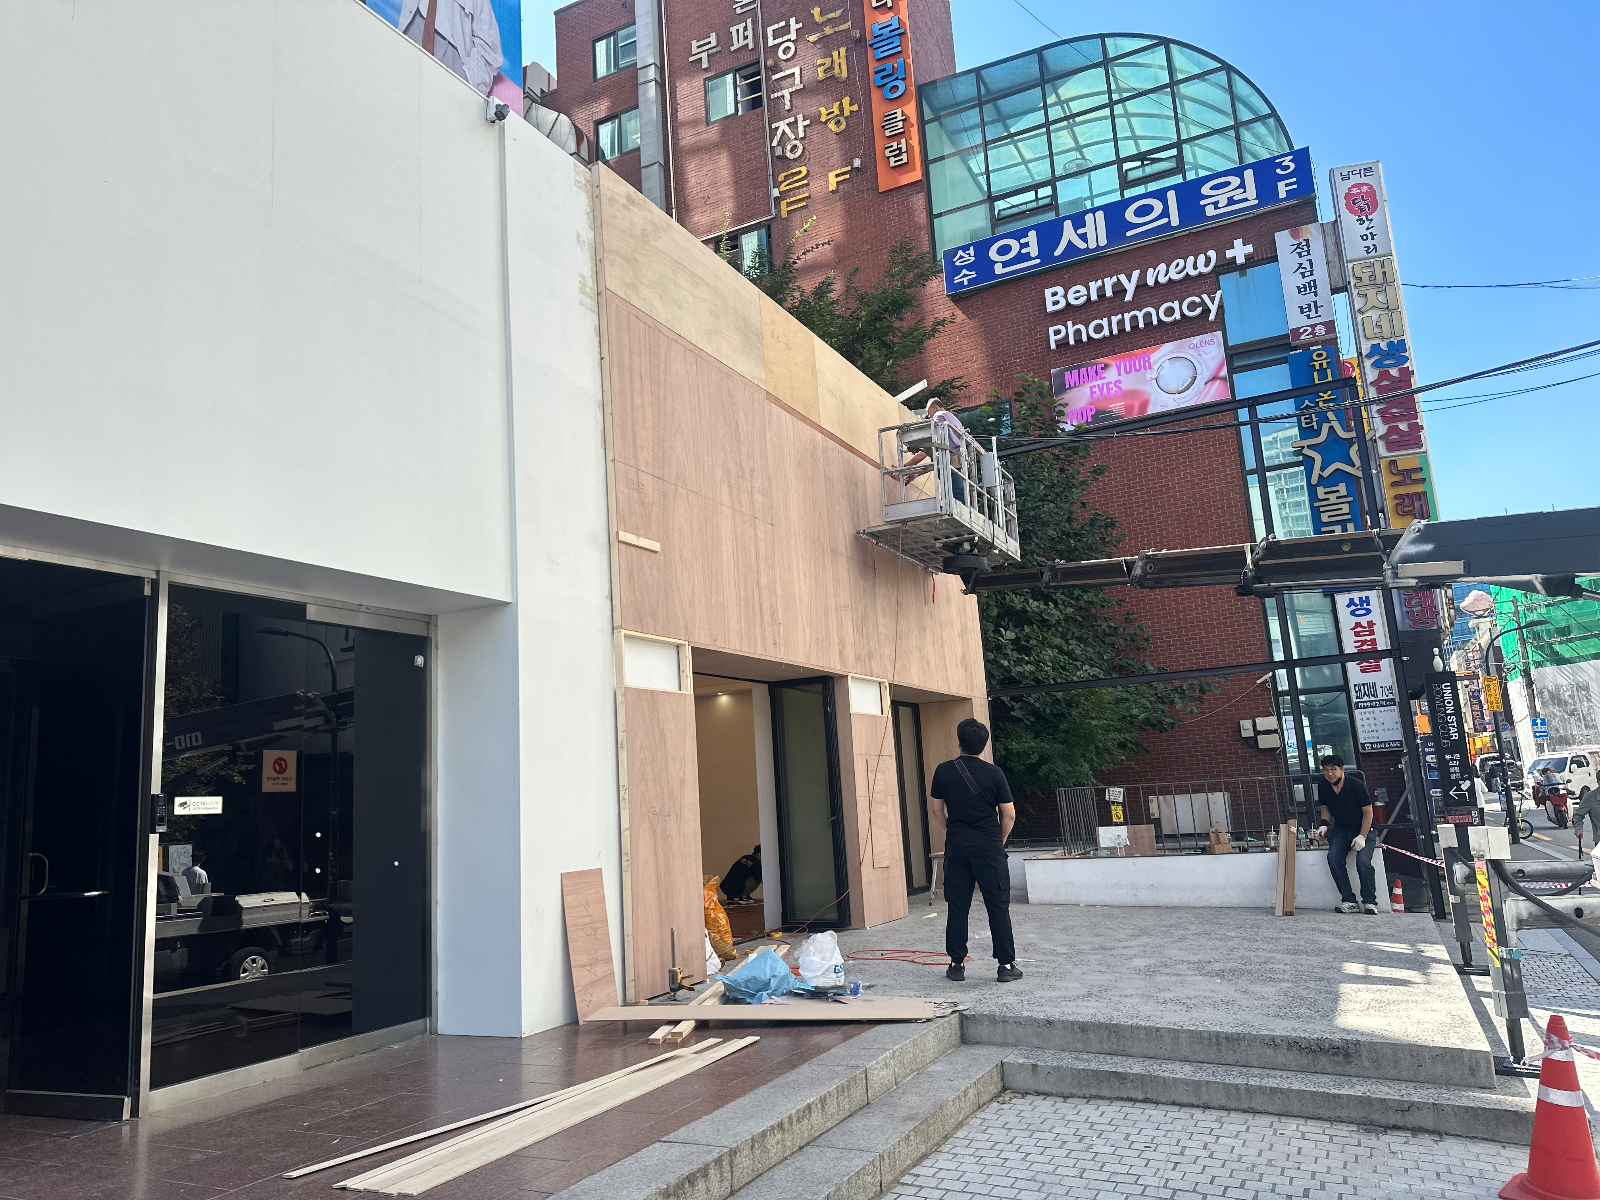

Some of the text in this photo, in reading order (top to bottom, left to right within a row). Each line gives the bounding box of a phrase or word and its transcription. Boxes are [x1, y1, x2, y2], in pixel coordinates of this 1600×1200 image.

[765, 16, 811, 160] 당구장
[805, 5, 859, 134] 노래방
[988, 168, 1258, 275] 연세의원
[1044, 249, 1217, 313] Berry new
[1290, 238, 1324, 320] 점심백반
[1048, 290, 1222, 350] Pharmacy
[1299, 325, 1327, 340] 2층
[1064, 353, 1152, 388] MAKE YOUR
[1089, 379, 1124, 402] EYES
[1068, 404, 1096, 425] POP
[1441, 683, 1459, 740] UNION STAR
